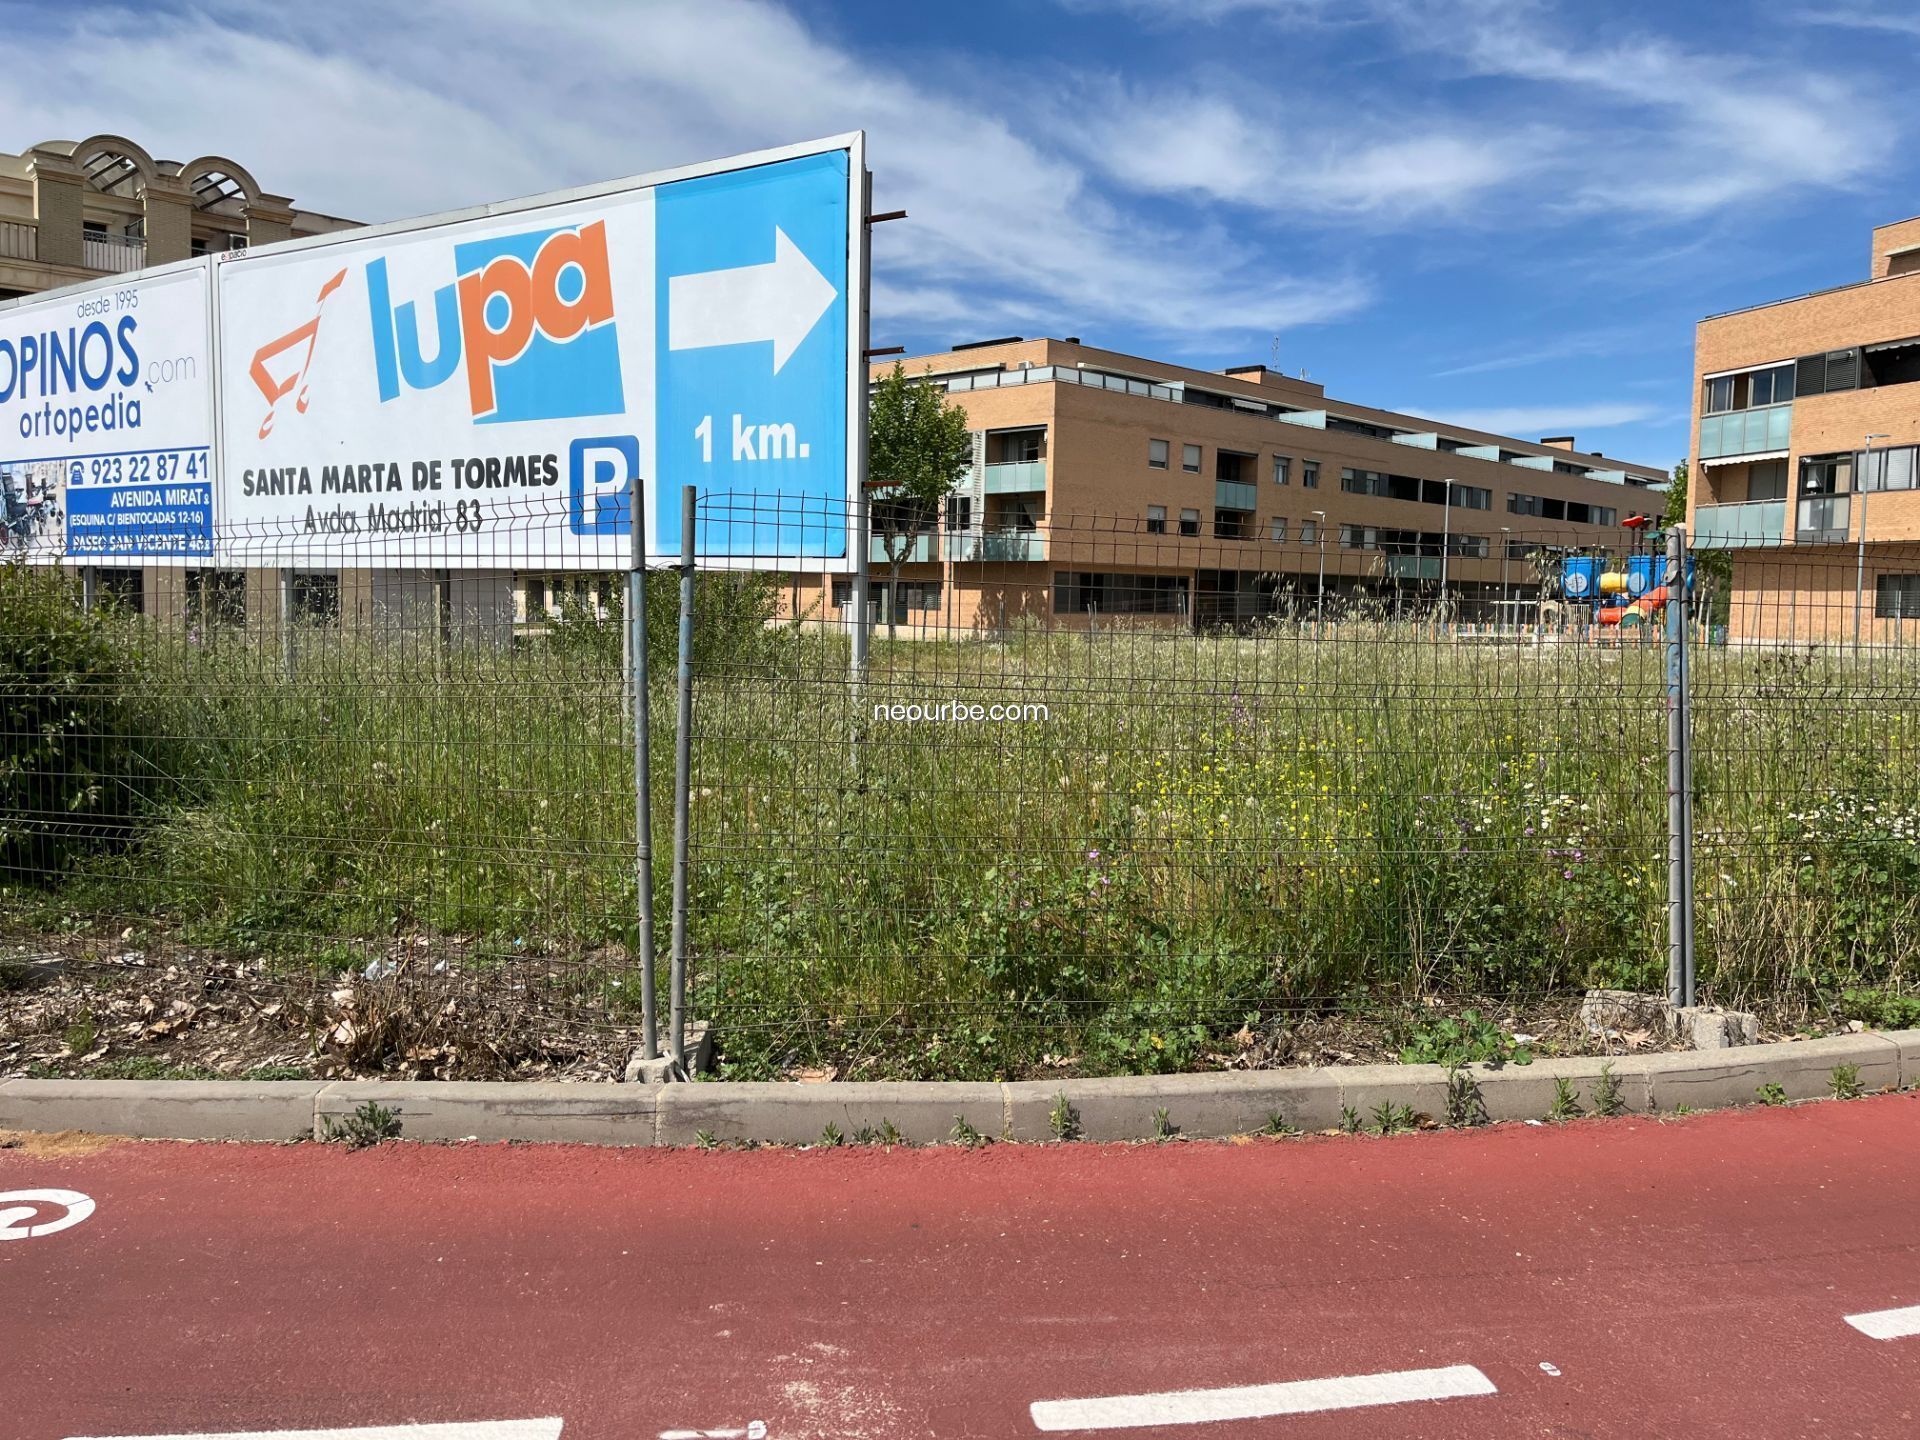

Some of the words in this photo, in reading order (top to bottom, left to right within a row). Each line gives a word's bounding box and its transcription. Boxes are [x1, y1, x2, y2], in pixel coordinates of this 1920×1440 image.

[77, 297, 111, 318] desde
[115, 289, 139, 311] 1995
[365, 218, 614, 416] lupa
[19, 391, 142, 443] ortopedia
[694, 415, 713, 463] 1
[732, 413, 811, 461] km.
[91, 457, 123, 485] 923
[128, 455, 151, 482] 22
[156, 453, 180, 481] 87
[186, 452, 208, 479] 41
[243, 466, 313, 497] SANTA
[321, 462, 403, 494] MARTA
[412, 460, 442, 491] DE
[450, 453, 560, 490] TORMES
[110, 490, 163, 508] AVENIDA
[165, 488, 204, 506] MIRAT
[582, 446, 630, 528] P
[69, 513, 106, 528] (ESQUINA
[107, 512, 116, 526] C/
[117, 511, 176, 526] BIENTOCADAS
[177, 510, 204, 526] 12-16)
[455, 498, 482, 534] 83
[72, 535, 108, 552] PASEO
[109, 534, 133, 552] SAN
[135, 534, 186, 551] VICENTE
